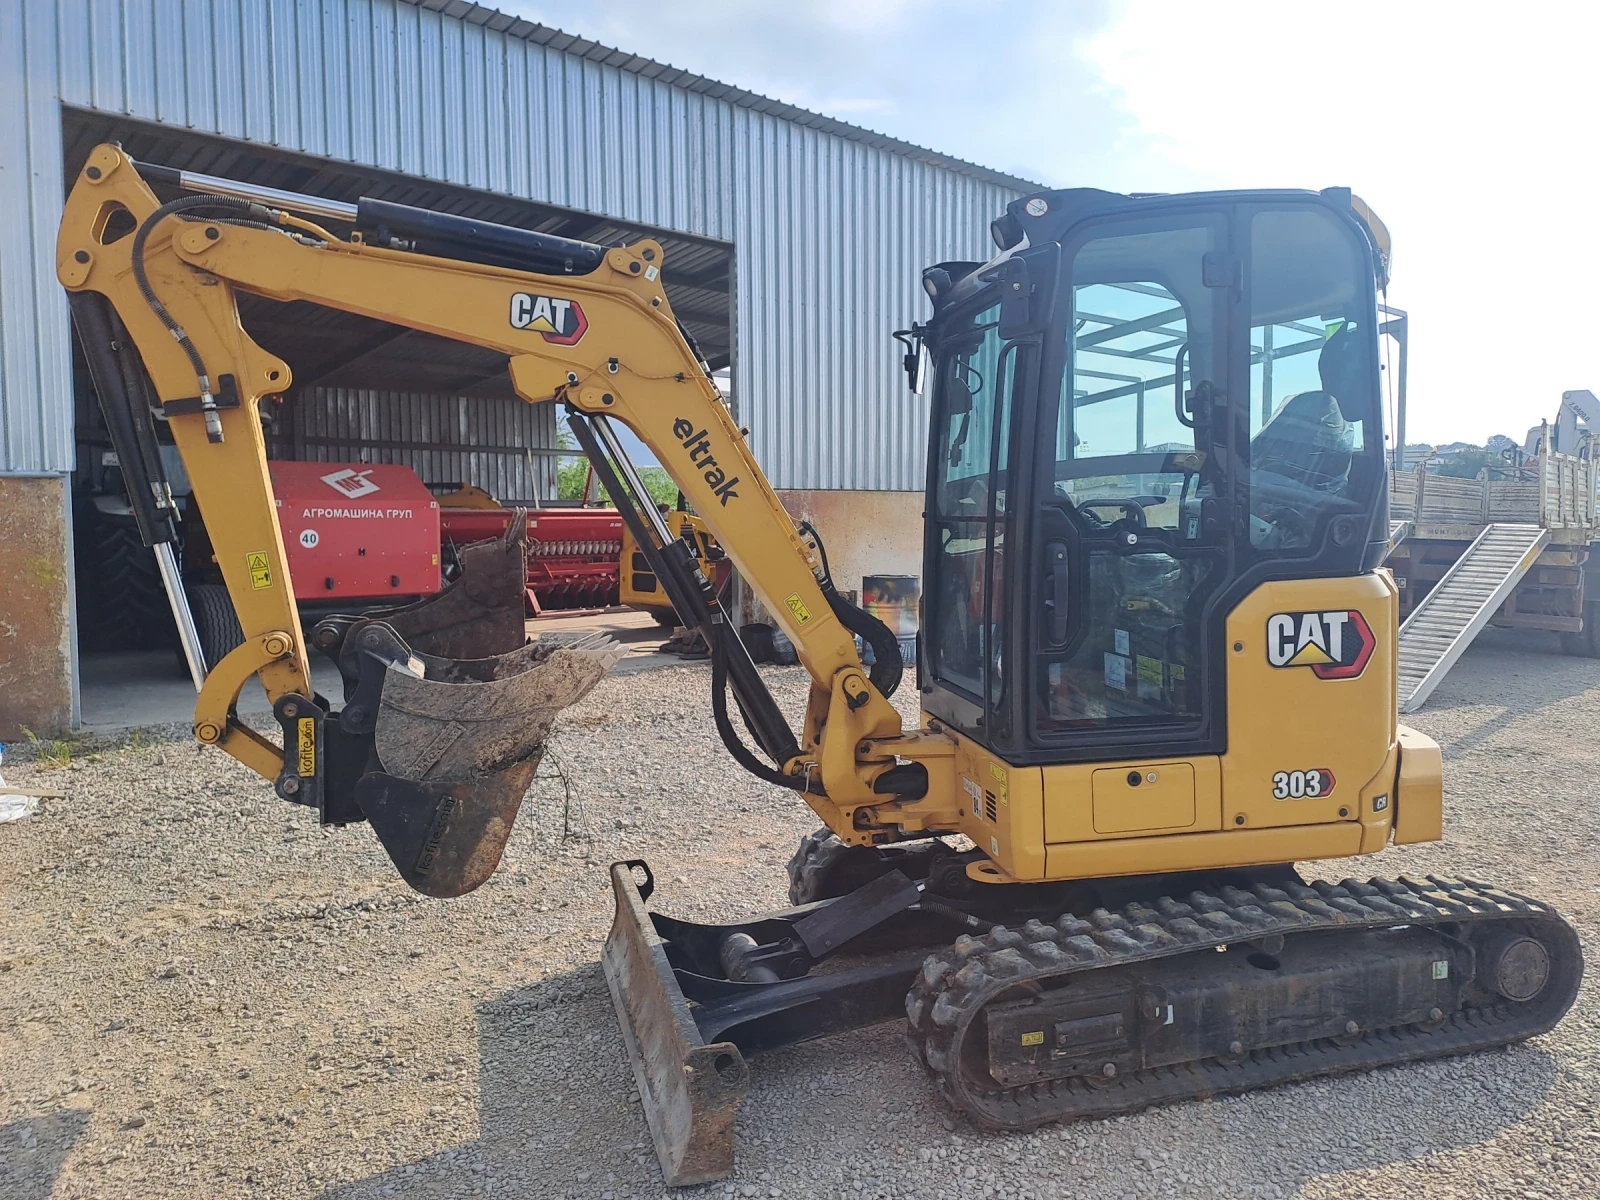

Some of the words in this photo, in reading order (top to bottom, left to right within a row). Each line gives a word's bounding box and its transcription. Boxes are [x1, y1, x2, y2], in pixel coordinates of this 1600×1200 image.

[510, 293, 571, 334] CAT
[672, 417, 740, 508] eltrak
[302, 508, 384, 519] АГРОМАШИНА
[386, 508, 413, 519] ГРУП
[301, 533, 317, 544] 40
[1267, 611, 1349, 666] CAT
[301, 720, 313, 775] kofite.com
[1273, 770, 1321, 799] 303
[1376, 796, 1387, 810] CR
[419, 800, 456, 870] kofite.com
